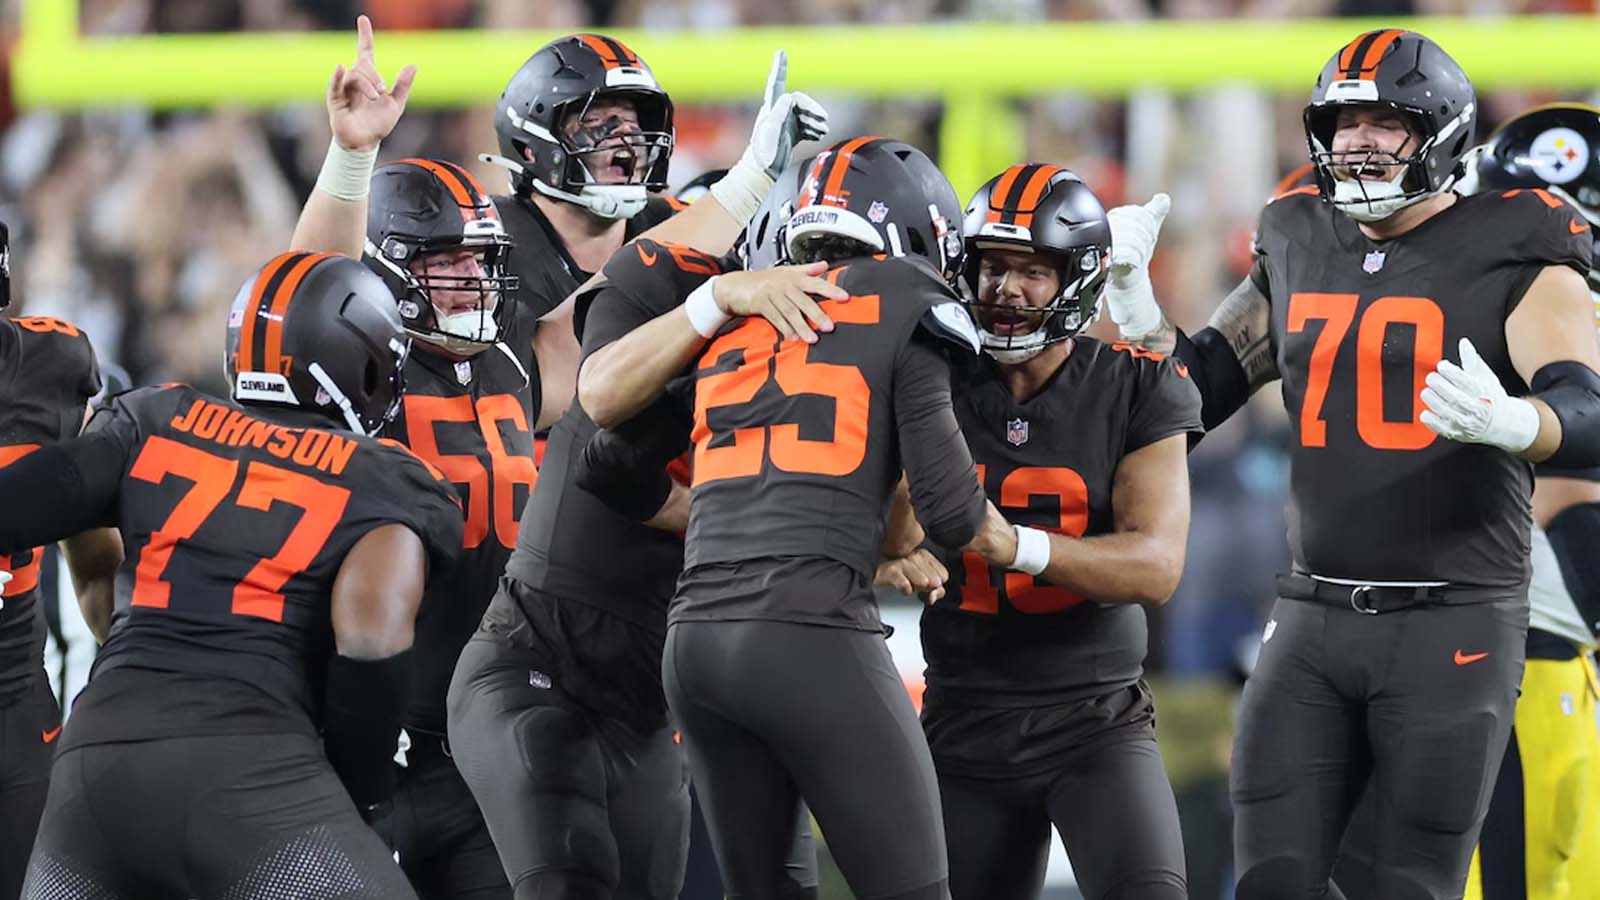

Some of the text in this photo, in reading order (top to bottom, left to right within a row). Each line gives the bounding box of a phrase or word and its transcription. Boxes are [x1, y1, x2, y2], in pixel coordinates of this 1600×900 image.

[170, 400, 359, 475] JOHNSON
[241, 381, 285, 393] CLEVELAND
[690, 294, 880, 489] 25
[1287, 293, 1446, 451] 70
[129, 434, 352, 623] 77
[403, 394, 539, 549] 56
